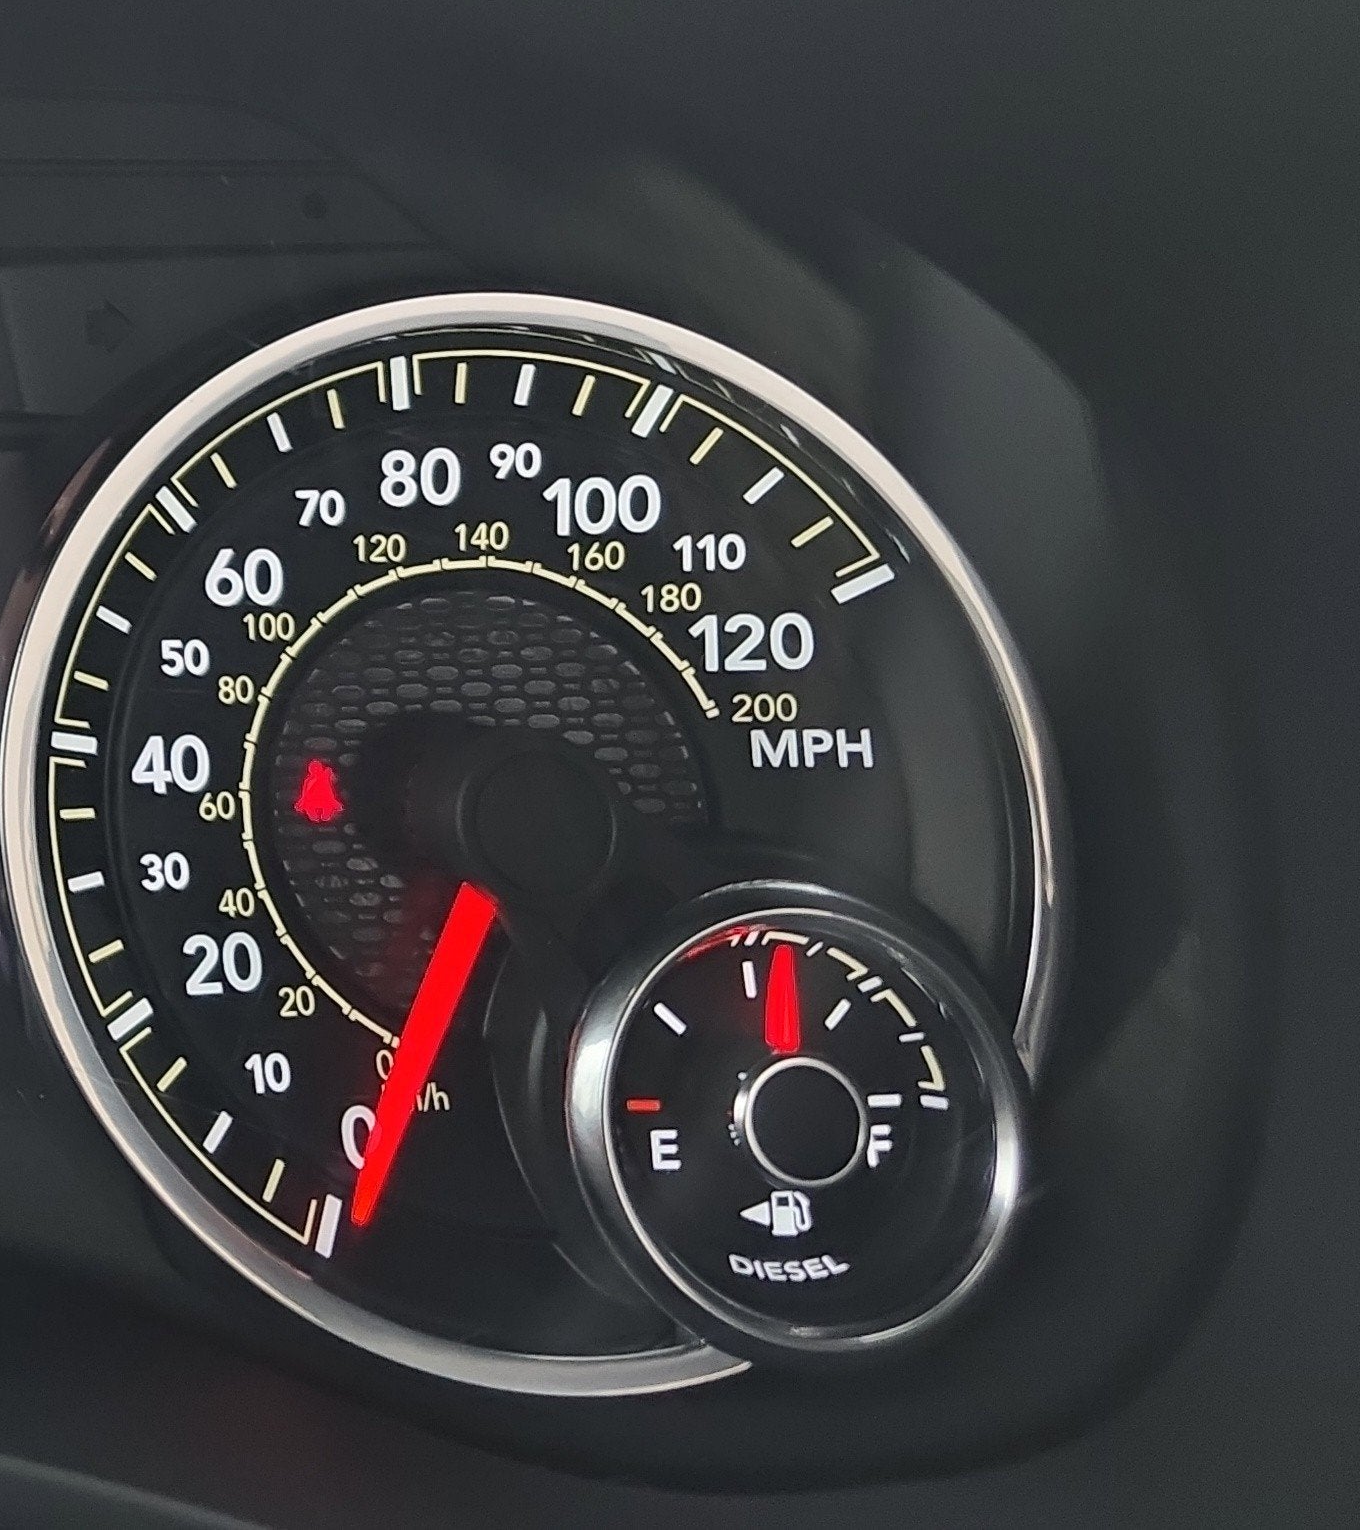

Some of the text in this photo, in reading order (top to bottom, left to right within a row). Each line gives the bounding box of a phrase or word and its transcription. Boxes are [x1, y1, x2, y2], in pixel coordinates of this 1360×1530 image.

[380, 447, 462, 507] 80
[488, 442, 543, 480] 90
[294, 488, 346, 527] 70
[542, 474, 662, 537] 100
[352, 533, 407, 563] 120
[453, 520, 510, 552] 140
[672, 533, 747, 572] 110
[566, 540, 626, 572] 160
[204, 547, 284, 607] 60
[640, 582, 703, 614] 180
[242, 612, 296, 642] 100
[687, 611, 815, 673] 120
[160, 638, 211, 677] 50
[218, 674, 255, 705] 80
[731, 693, 799, 723] 200
[131, 734, 211, 795] 40
[749, 727, 874, 769] MPH
[198, 791, 236, 821] 60
[139, 852, 191, 892] 30
[218, 888, 256, 918] 40
[181, 931, 264, 996] 20
[278, 987, 316, 1017] 20
[244, 1052, 292, 1094] 10
[650, 1129, 682, 1170] E
[867, 1124, 893, 1168] F
[729, 1253, 851, 1282] DIESEL
